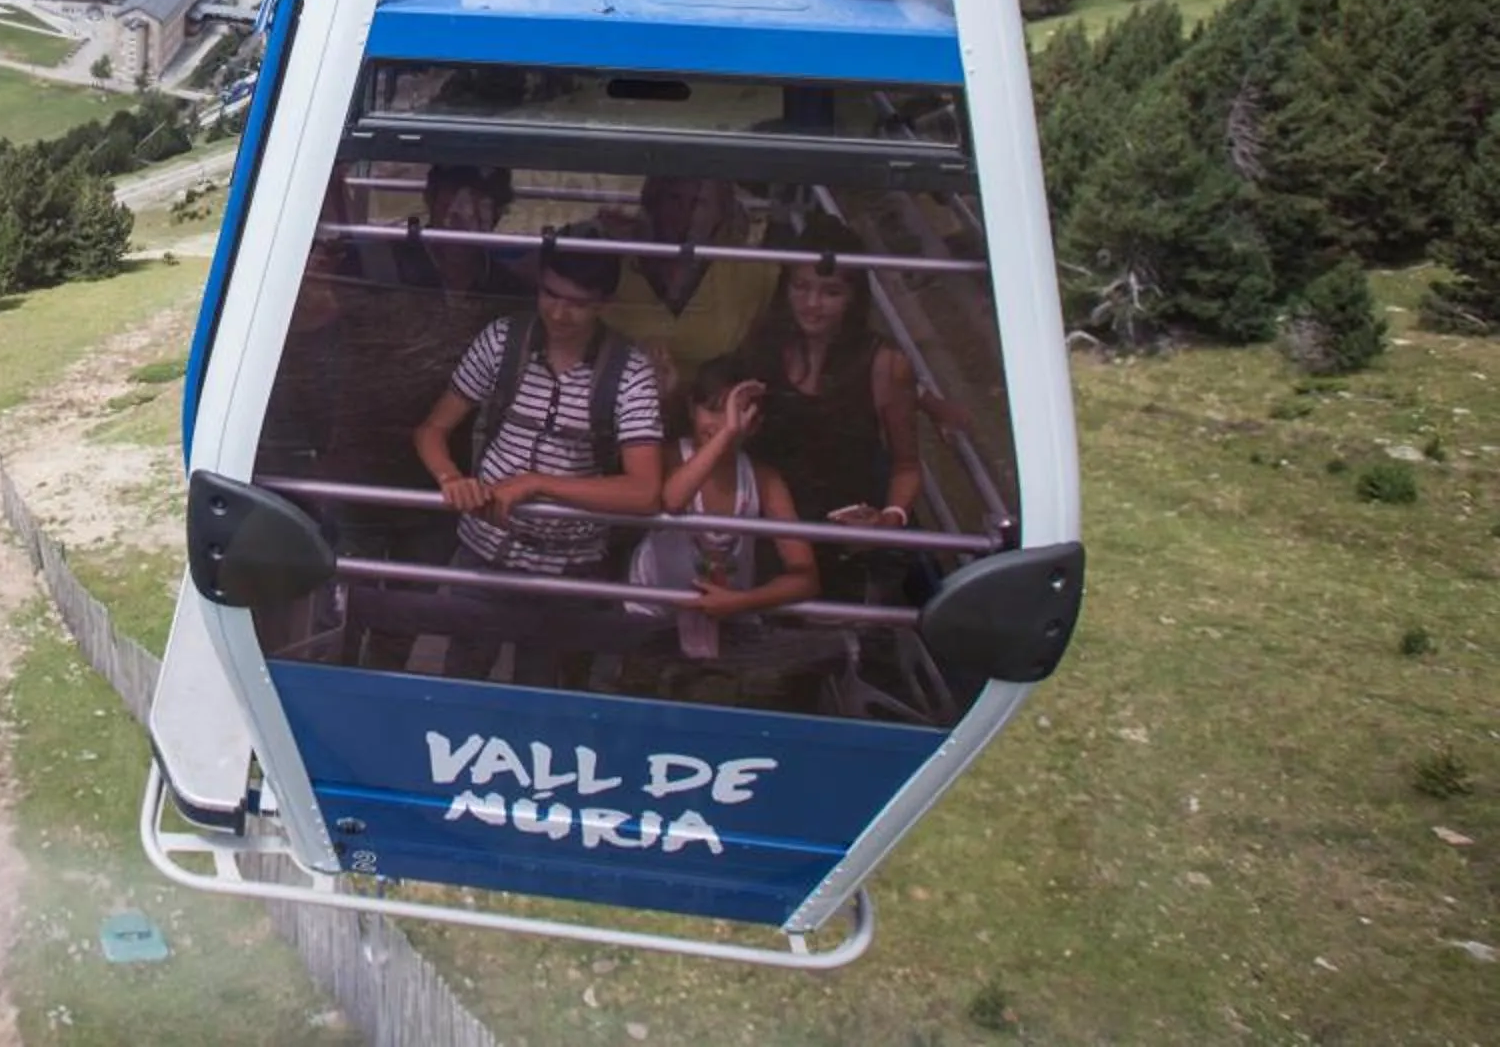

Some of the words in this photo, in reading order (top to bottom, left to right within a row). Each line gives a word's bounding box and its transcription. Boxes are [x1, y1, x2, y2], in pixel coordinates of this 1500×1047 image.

[426, 731, 621, 795] VALL
[643, 753, 779, 804] DE
[444, 788, 725, 854] NÚRIA
